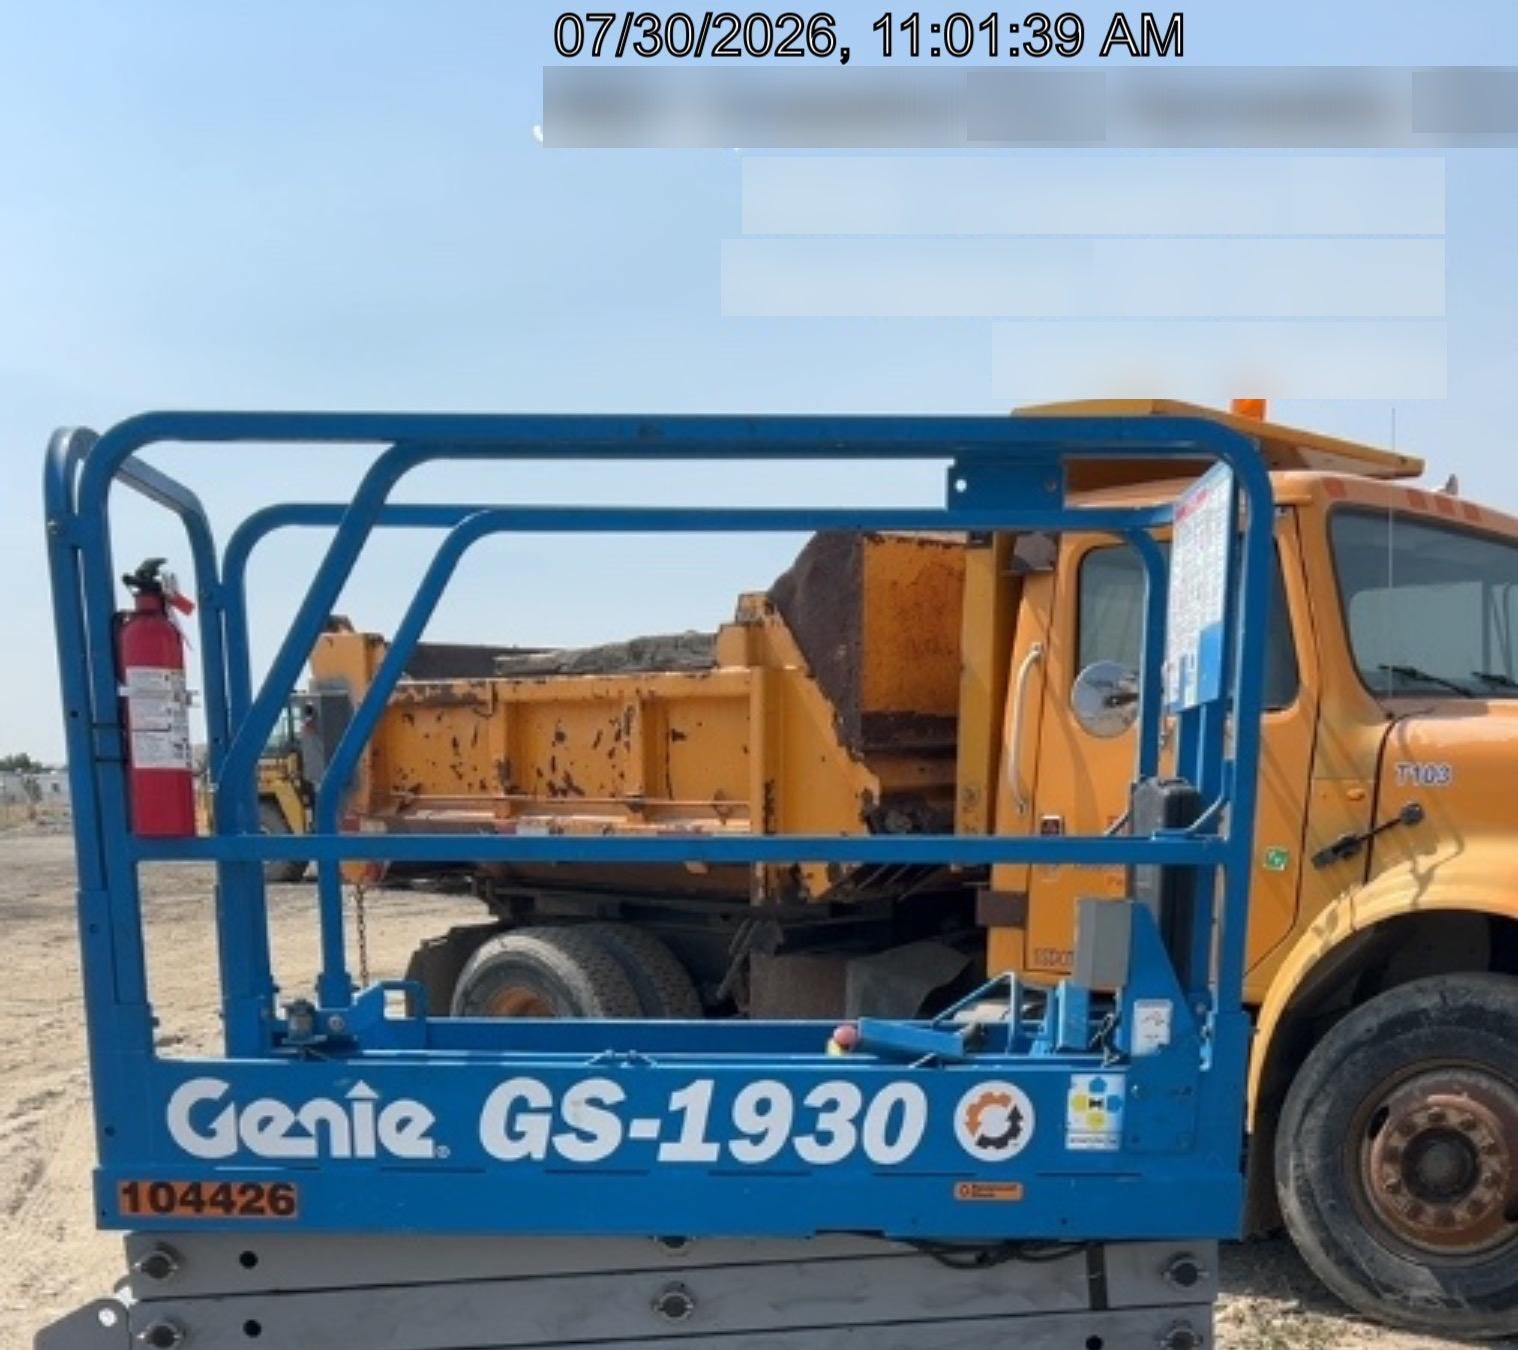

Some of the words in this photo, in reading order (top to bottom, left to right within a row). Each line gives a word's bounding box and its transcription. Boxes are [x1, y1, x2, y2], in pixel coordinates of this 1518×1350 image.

[166, 1077, 436, 1159] Genie
[478, 1076, 928, 1166] GS-1930
[121, 1181, 297, 1216] 104426
